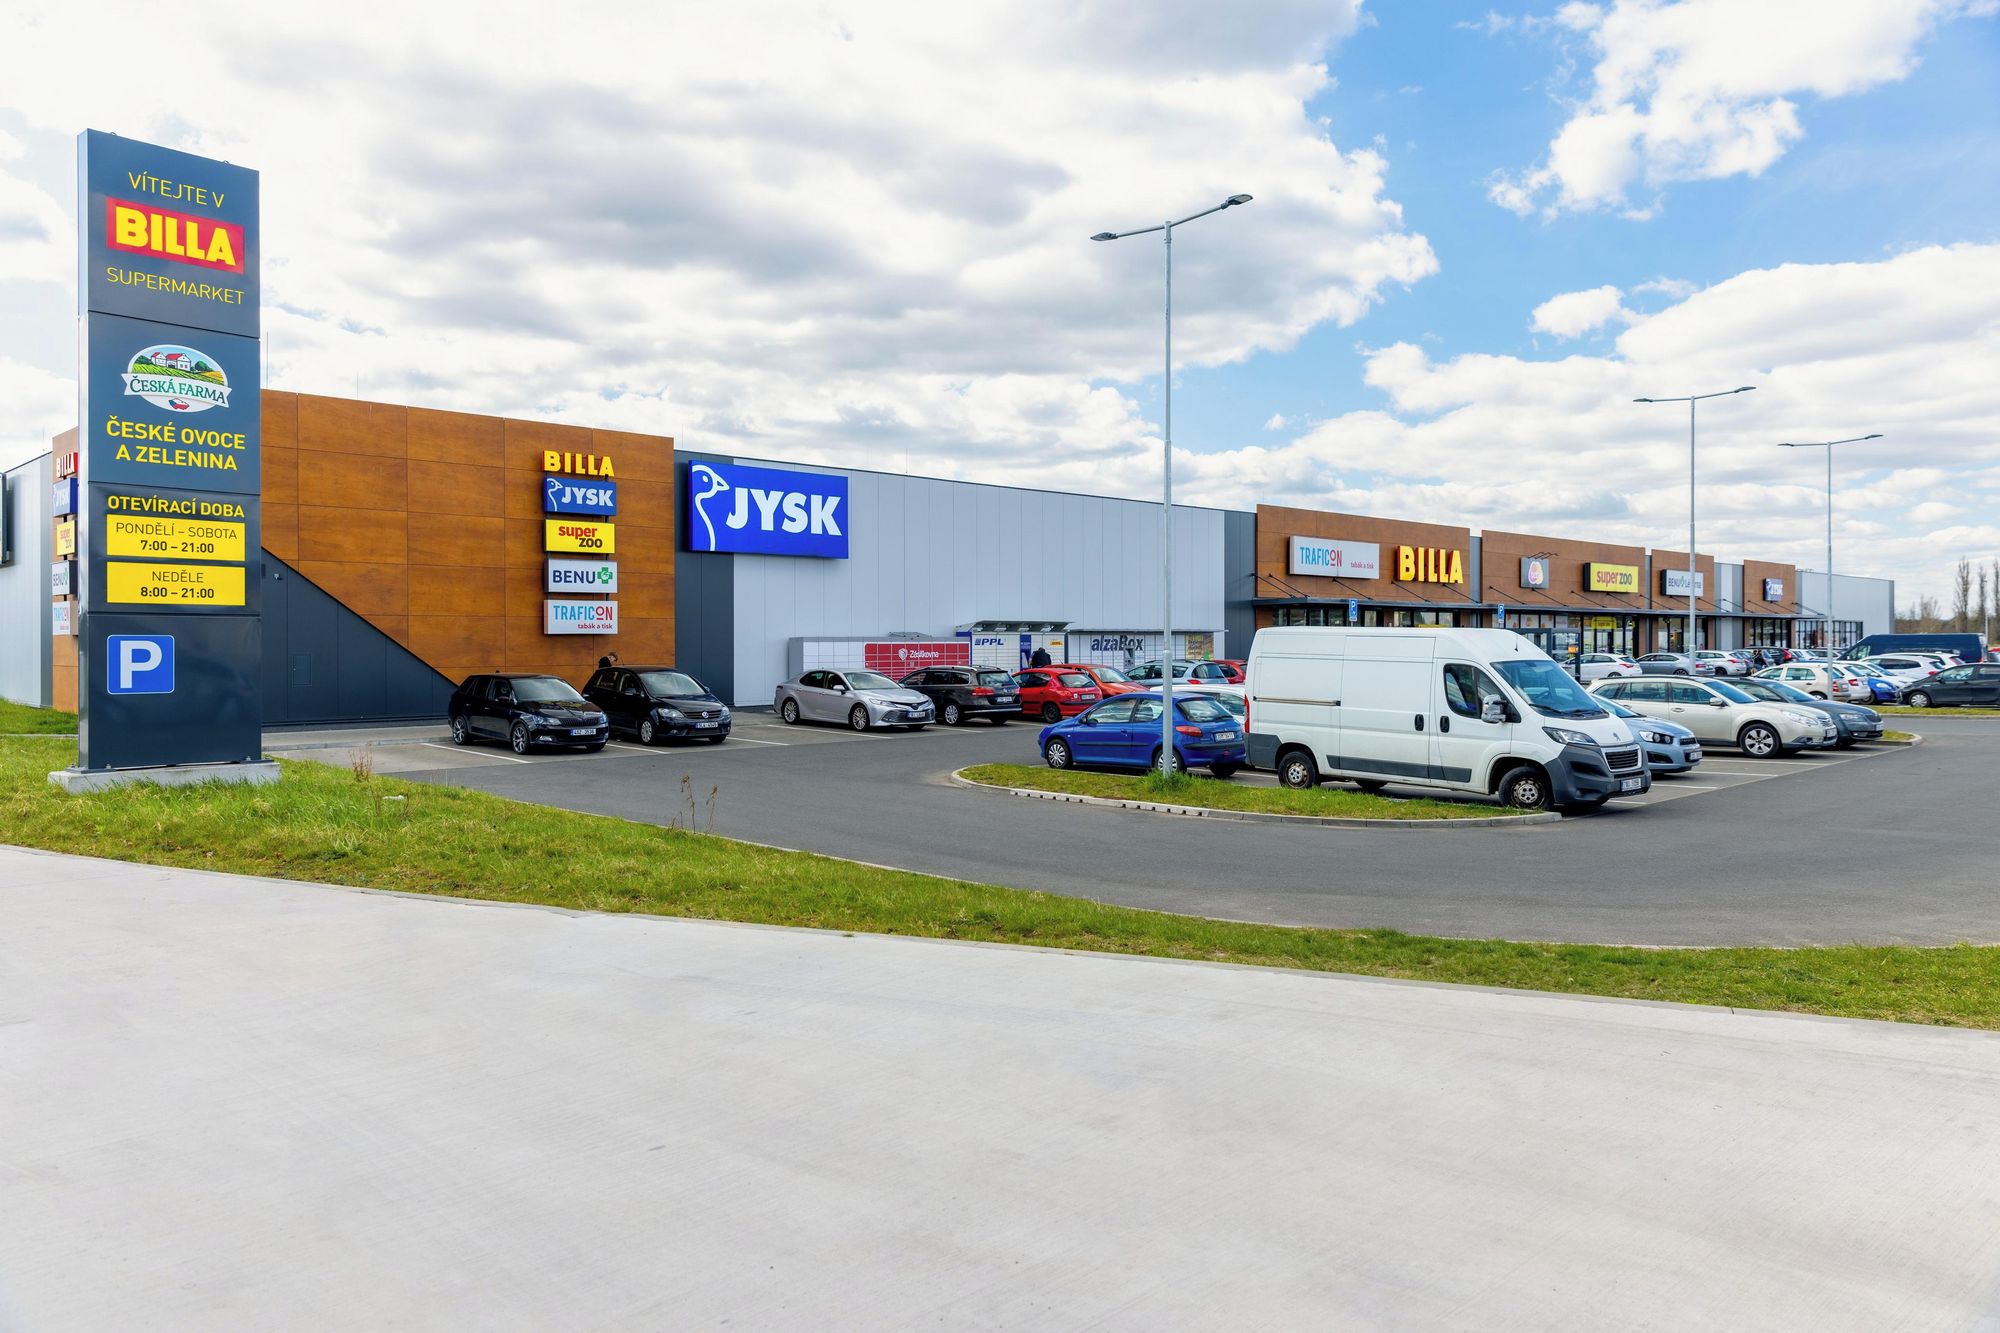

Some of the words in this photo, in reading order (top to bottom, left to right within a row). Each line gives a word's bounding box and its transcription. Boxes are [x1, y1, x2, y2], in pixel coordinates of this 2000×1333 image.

[128, 171, 207, 205] VÍTEJTE
[212, 191, 225, 208] V
[115, 206, 236, 266] BILLA
[107, 267, 245, 305] SUPERMARKET
[130, 375, 177, 394] ČESKÁ
[178, 383, 226, 404] FARMA
[106, 415, 176, 443] ČESKÉ
[181, 428, 246, 450] OVOCE
[56, 452, 75, 478] BILLA
[115, 444, 131, 461] A
[135, 445, 238, 471] ZELENINA
[543, 450, 615, 477] BILLA
[107, 495, 196, 515] OTEVÍRACÍ
[200, 502, 245, 518] DOBA
[561, 486, 614, 507] JYSK
[726, 487, 842, 536] JYSK
[116, 522, 175, 536] PONDĚLÍ
[188, 527, 238, 540] SOBOTA
[558, 525, 598, 540] super
[140, 540, 168, 551] 7:00
[181, 542, 214, 553] 21:00
[578, 537, 603, 548] zoo
[1300, 546, 1342, 567] TRAFICON
[1398, 545, 1463, 584] BILLA
[152, 570, 204, 583] NEDĚLE
[552, 570, 596, 584] BENU
[1597, 571, 1618, 587] super
[1619, 572, 1632, 585] zoo
[140, 587, 168, 597] 8:00
[181, 588, 214, 598] 21:00
[553, 605, 613, 621] TRAFICON
[982, 638, 1004, 646] PPL
[1091, 634, 1143, 651] alzaBox
[120, 640, 163, 689] P
